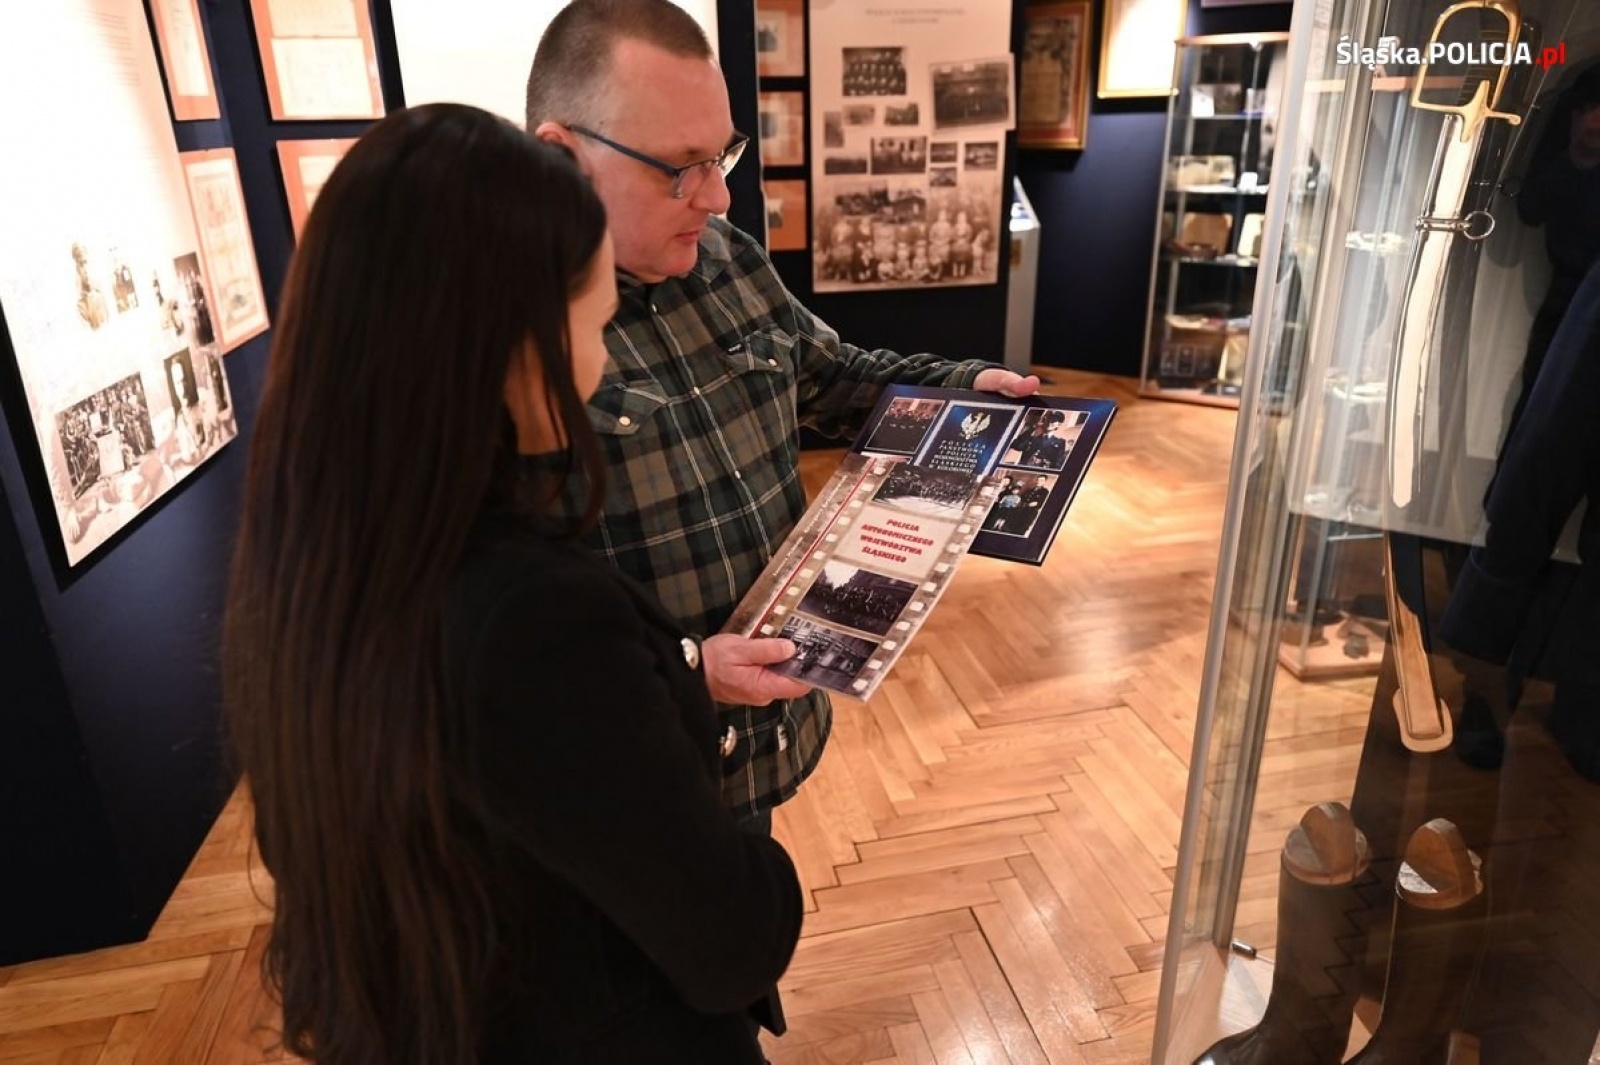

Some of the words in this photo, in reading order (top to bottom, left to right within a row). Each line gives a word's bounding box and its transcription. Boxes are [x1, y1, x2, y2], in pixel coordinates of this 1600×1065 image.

[941, 440, 986, 449] POLICJA
[886, 519, 920, 532] POLICJA
[861, 524, 935, 547] AUTONOMICZNEGO
[860, 534, 923, 556] WOJEWÓDZTWA
[861, 546, 908, 563] ŚLĄSKIEGO
